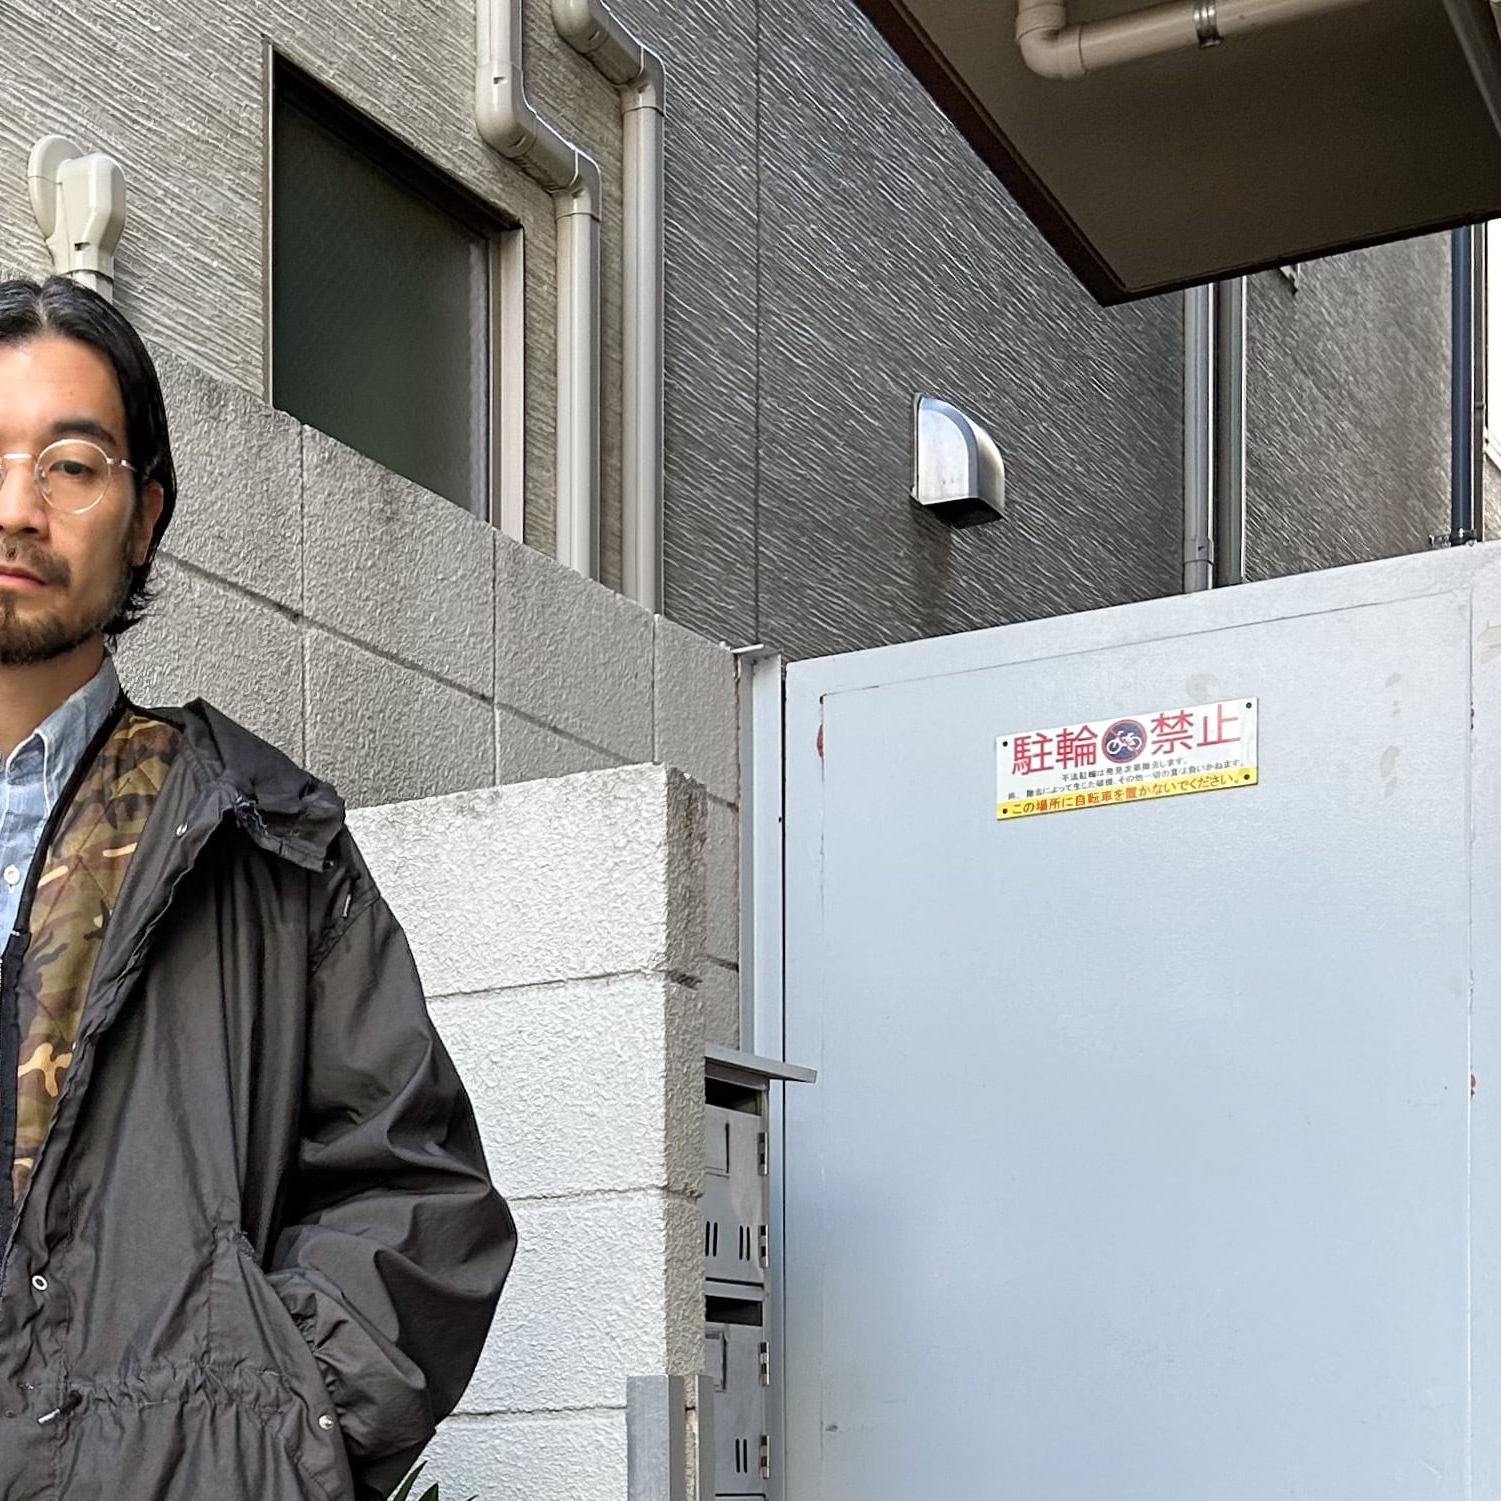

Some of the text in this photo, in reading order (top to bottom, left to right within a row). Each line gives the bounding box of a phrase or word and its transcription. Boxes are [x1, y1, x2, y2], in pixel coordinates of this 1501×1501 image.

[1011, 703, 1242, 776] 駐輪 禁止
[1011, 773, 1240, 815] この場所に自転車を置かないでください。
